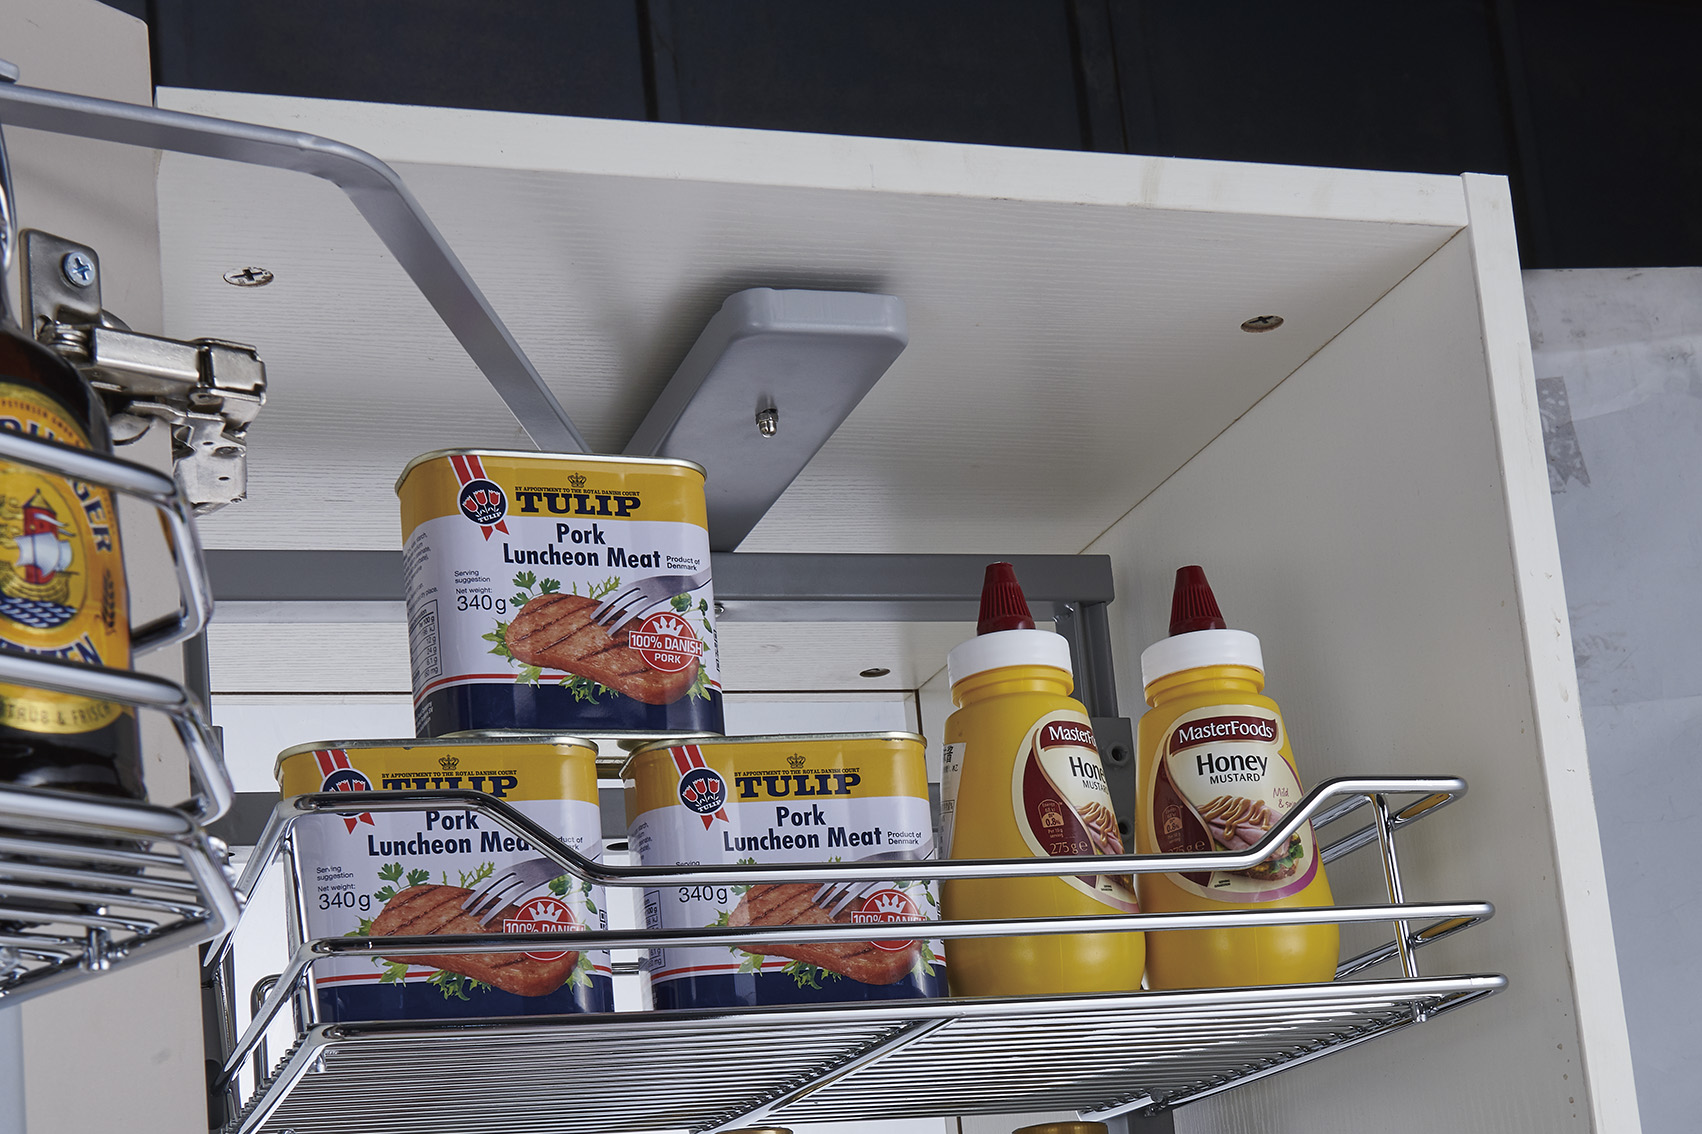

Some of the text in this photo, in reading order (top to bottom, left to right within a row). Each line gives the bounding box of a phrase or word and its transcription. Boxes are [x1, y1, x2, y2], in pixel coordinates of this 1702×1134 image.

[515, 492, 641, 517] TULIP
[477, 511, 502, 522] TULIP
[556, 522, 606, 546] Pork
[502, 543, 661, 568] Luncheon Meat
[666, 555, 694, 564] Product
[454, 570, 480, 578] Serving
[667, 562, 698, 571] Denmark
[455, 576, 491, 584] suggestion
[469, 587, 493, 595] weight:
[457, 594, 507, 615] 340 g
[632, 634, 702, 655] 100% DANISH
[654, 652, 682, 664] PORK
[1179, 721, 1273, 744] MasterFoods
[1196, 753, 1268, 777] Honey
[735, 773, 861, 798] TULIP
[1209, 772, 1261, 785] MUSTARD
[1273, 787, 1289, 798] Mild
[698, 799, 722, 812] TULIP
[425, 810, 480, 831] Pork
[776, 804, 827, 827] Pork
[723, 827, 882, 852] Luncheon Meat
[887, 831, 915, 839] Product
[368, 832, 472, 857] Luncheon
[1050, 842, 1070, 855] 275
[1070, 843, 1079, 855] g
[316, 866, 342, 874] Serving
[317, 872, 354, 881] suggestion
[319, 891, 371, 912] 340 g
[678, 886, 728, 904] 340 g
